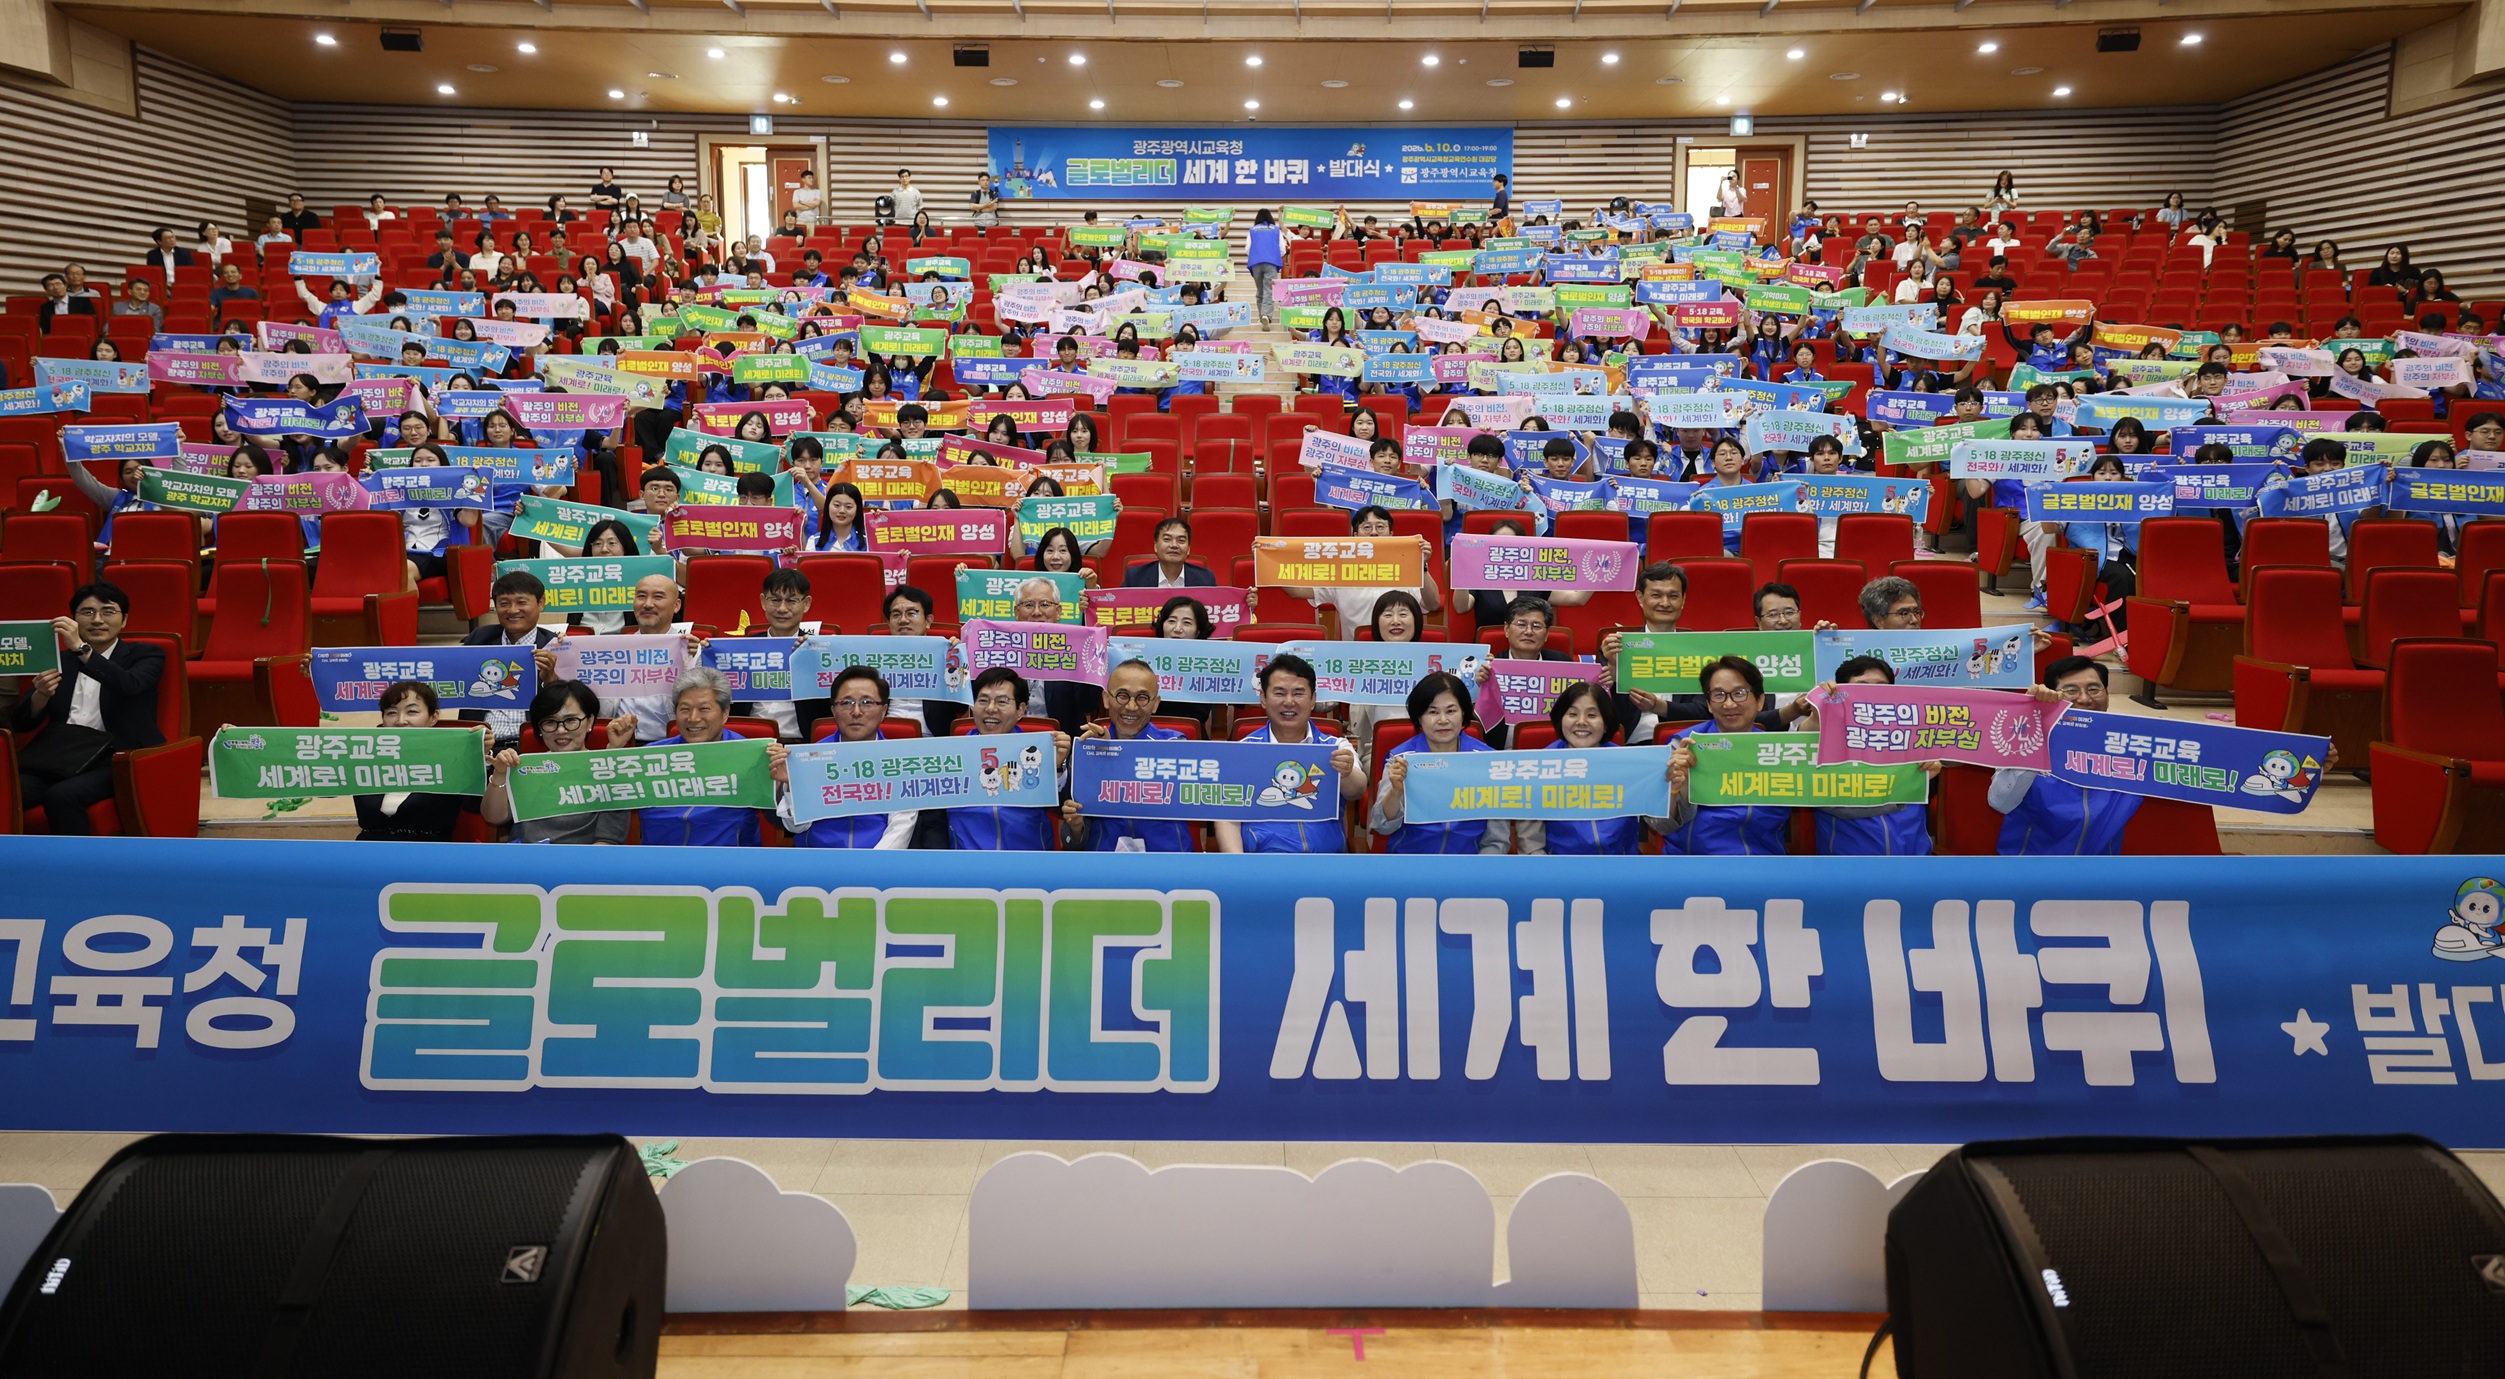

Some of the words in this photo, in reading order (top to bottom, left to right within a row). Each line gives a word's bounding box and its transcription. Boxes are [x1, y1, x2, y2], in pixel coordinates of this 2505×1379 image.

[1133, 140, 1243, 155] 광주광역시교육청
[1066, 158, 1177, 187] 글로벌리더
[1183, 159, 1228, 184] 세계
[1235, 159, 1258, 184] 한
[1264, 159, 1309, 184] 바퀴
[1329, 160, 1380, 178] 발대식
[1637, 376, 1677, 388] 광주교육
[523, 401, 554, 412] 광주의
[1567, 403, 1604, 415] 광주정신
[1673, 402, 1714, 415] 광주정신
[1888, 398, 1926, 409] 광주교육
[520, 412, 551, 422] 광주의
[1574, 415, 1606, 426] 세계화!
[1682, 413, 1717, 424] 세계화!
[1784, 421, 1825, 434] 광주정신
[1922, 425, 1975, 440] 광주교육
[84, 434, 134, 443] 학교자치의
[1311, 436, 1340, 452] 광주의
[1344, 442, 1365, 458] 비전,
[1406, 434, 1437, 446] 광주의
[1440, 436, 1465, 448] 비전,
[2204, 432, 2252, 445] 광주교육
[90, 444, 110, 454] 광주
[114, 443, 155, 453] 학교자치
[1906, 442, 1949, 458] 세계로!
[1971, 450, 1996, 460] 5·18
[2000, 449, 2046, 462] 광주정신
[471, 456, 517, 468] 광주정신
[1306, 448, 1335, 463] 광주의
[1339, 455, 1368, 470] 자부심
[1967, 461, 2004, 473] 전국화!
[2008, 462, 2048, 474] 세계화!
[856, 463, 912, 479] 광주교육
[382, 476, 431, 489] 광주교육
[1349, 477, 1396, 495] 광주교육
[2175, 475, 2230, 487] 광주교육
[2305, 469, 2365, 492] 광주교육
[161, 480, 213, 495] 학교자치의
[216, 486, 238, 500] 모델,
[251, 483, 284, 496] 광주의
[288, 483, 316, 496] 비전,
[409, 488, 452, 500] 미래로!
[1821, 486, 1868, 500] 광주정신
[2204, 488, 2253, 500] 미래로!
[2411, 483, 2504, 502] 글로벌인재
[166, 491, 187, 502] 광주
[190, 495, 231, 508] 학교자치
[247, 497, 281, 510] 광주의
[286, 496, 322, 509] 자부심
[1328, 488, 1369, 505] 세계로!
[1372, 495, 1412, 509] 미래로!
[1733, 495, 1779, 509] 광주정신
[1829, 500, 1869, 513] 세계화!
[2043, 493, 2132, 510] 글로벌인재
[2138, 495, 2173, 510] 양성
[2284, 495, 2334, 512] 세계로!
[1036, 501, 1096, 517] 광주교육
[531, 524, 583, 541] 세계로!
[672, 519, 758, 538] 글로벌인재
[875, 525, 955, 542] 글로벌인재
[960, 523, 995, 540] 양성
[1304, 542, 1373, 559] 광주교육
[1489, 546, 1533, 562] 광주의
[1538, 548, 1572, 565] 비전,
[548, 564, 623, 583] 광주교육
[1278, 563, 1335, 580] 세계로!
[1342, 563, 1400, 580] 미래로!
[1484, 564, 1529, 580] 광주의
[1532, 565, 1577, 581] 자부심
[978, 631, 1027, 648] 광주의
[1032, 633, 1072, 651] 비전,
[580, 651, 631, 665] 광주의
[636, 649, 674, 665] 비전,
[715, 652, 783, 669] 광주교육
[821, 652, 860, 667] 5·18
[866, 651, 933, 669] 광주정신
[973, 650, 1022, 667] 광주의
[1026, 652, 1077, 670] 자부심
[1890, 644, 1958, 664] 광주정신
[363, 662, 434, 680] 광주교육
[1176, 654, 1240, 673] 광주정신
[1349, 659, 1413, 681] 광주정신
[1756, 655, 1801, 677] 양성
[1904, 663, 1957, 680] 세계화!
[577, 669, 625, 684] 광주의
[1188, 674, 1243, 693] 세계화!
[1853, 703, 1918, 726] 광주의
[1925, 704, 1976, 727] 비전,
[295, 735, 401, 760] 광주교육
[1847, 728, 1910, 751] 광주의
[1915, 729, 1981, 750] 자부심
[2104, 731, 2201, 762] 광주교육
[589, 751, 696, 780] 광주교육
[827, 760, 875, 780] 5·18
[881, 756, 962, 776] 광주정신
[1135, 757, 1220, 782] 광주교육
[1489, 759, 1588, 780] 광주교육
[2065, 750, 2145, 781] 세계로!
[2154, 762, 2239, 793] 미래로!
[257, 764, 347, 789] 세계로!
[355, 764, 444, 787] 미래로!
[1720, 772, 1803, 797] 세계로!
[1813, 774, 1895, 797] 미래로!
[558, 782, 645, 806] 세계로!
[654, 774, 739, 800] 미래로!
[822, 782, 891, 805] 전국화!
[900, 777, 969, 797] 세계화!
[1099, 781, 1173, 805] 세계로!
[1179, 782, 1254, 807] 미래로!
[1451, 787, 1532, 810] 세계로!
[1542, 785, 1622, 809] 미래로!
[359, 882, 1221, 1095] 글로벌리더
[1270, 897, 1611, 1081] 세계
[1650, 896, 1824, 1085] 한
[1864, 899, 2217, 1088] 바퀴
